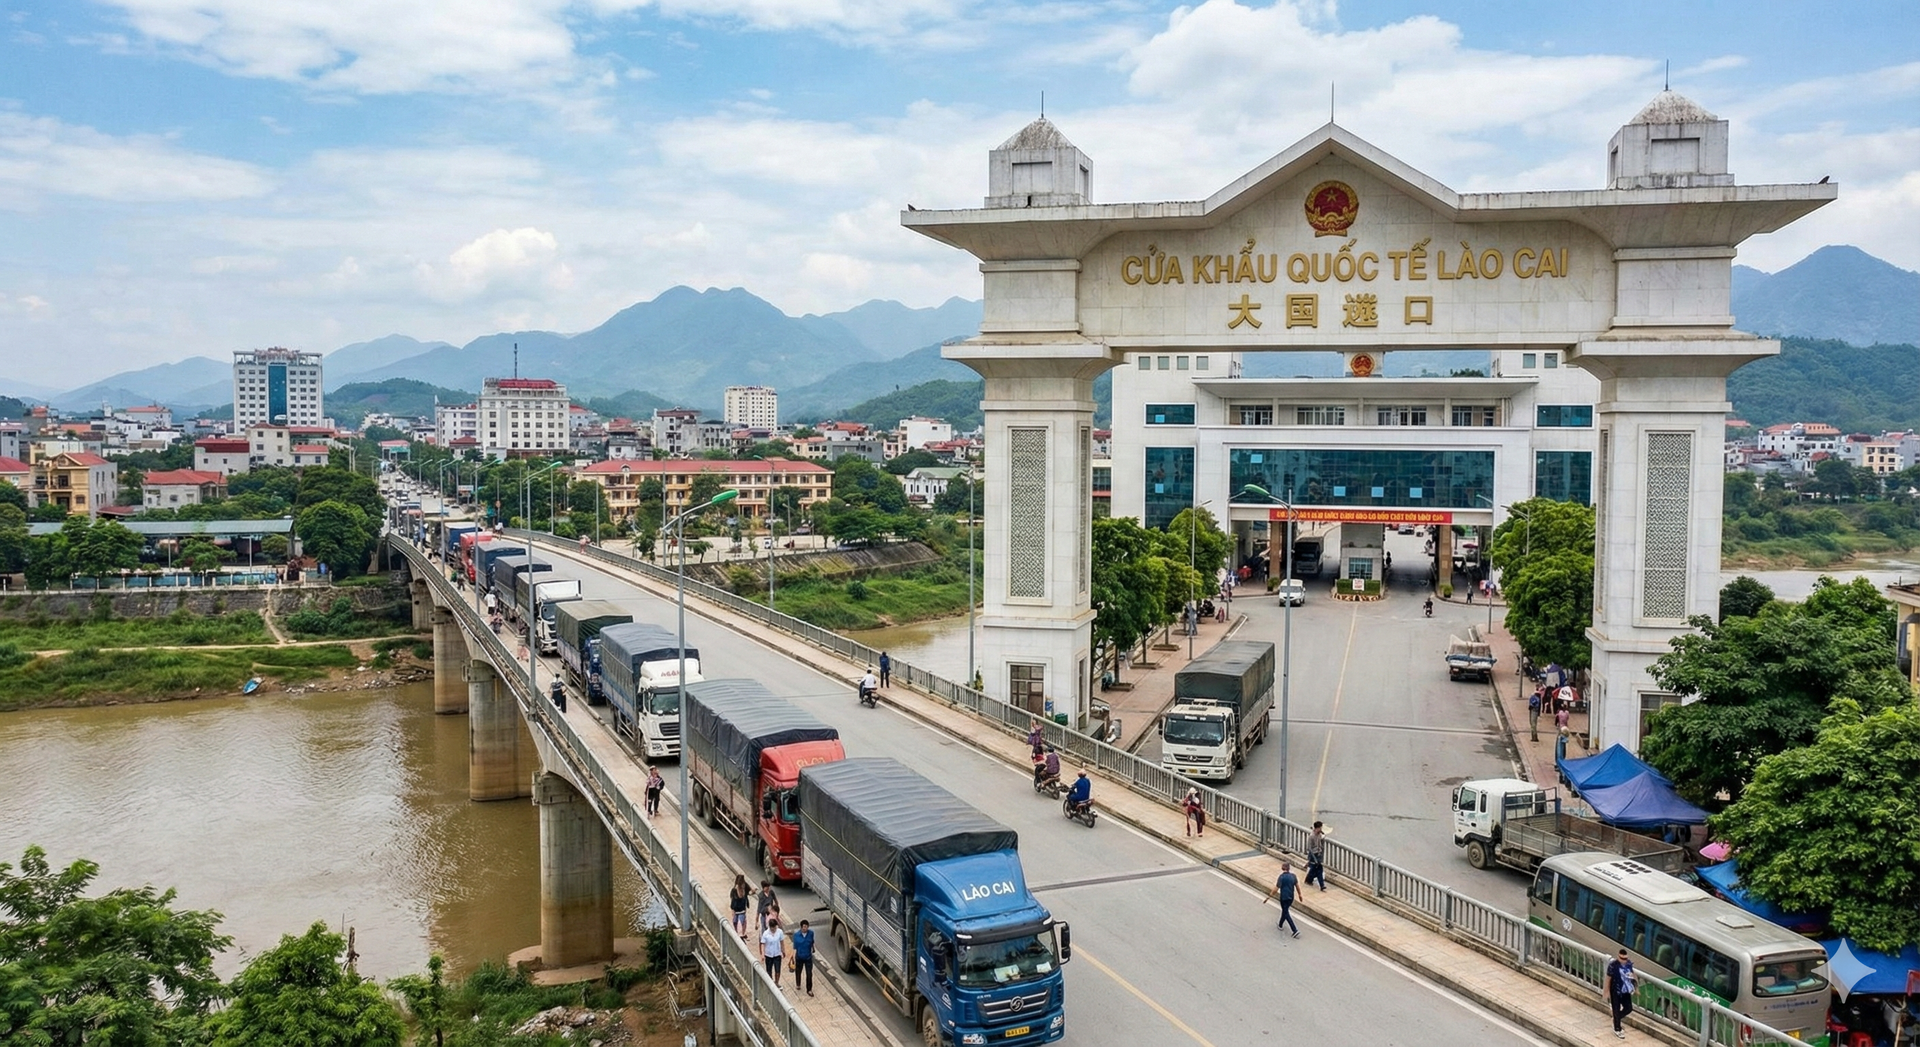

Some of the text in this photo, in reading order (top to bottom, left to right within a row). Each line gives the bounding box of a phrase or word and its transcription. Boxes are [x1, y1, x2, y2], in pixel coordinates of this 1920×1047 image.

[1121, 238, 1571, 285] CỬA KHẨU QUỐC TẾ LÀO CAI
[961, 880, 1016, 901] LÀO CAI
